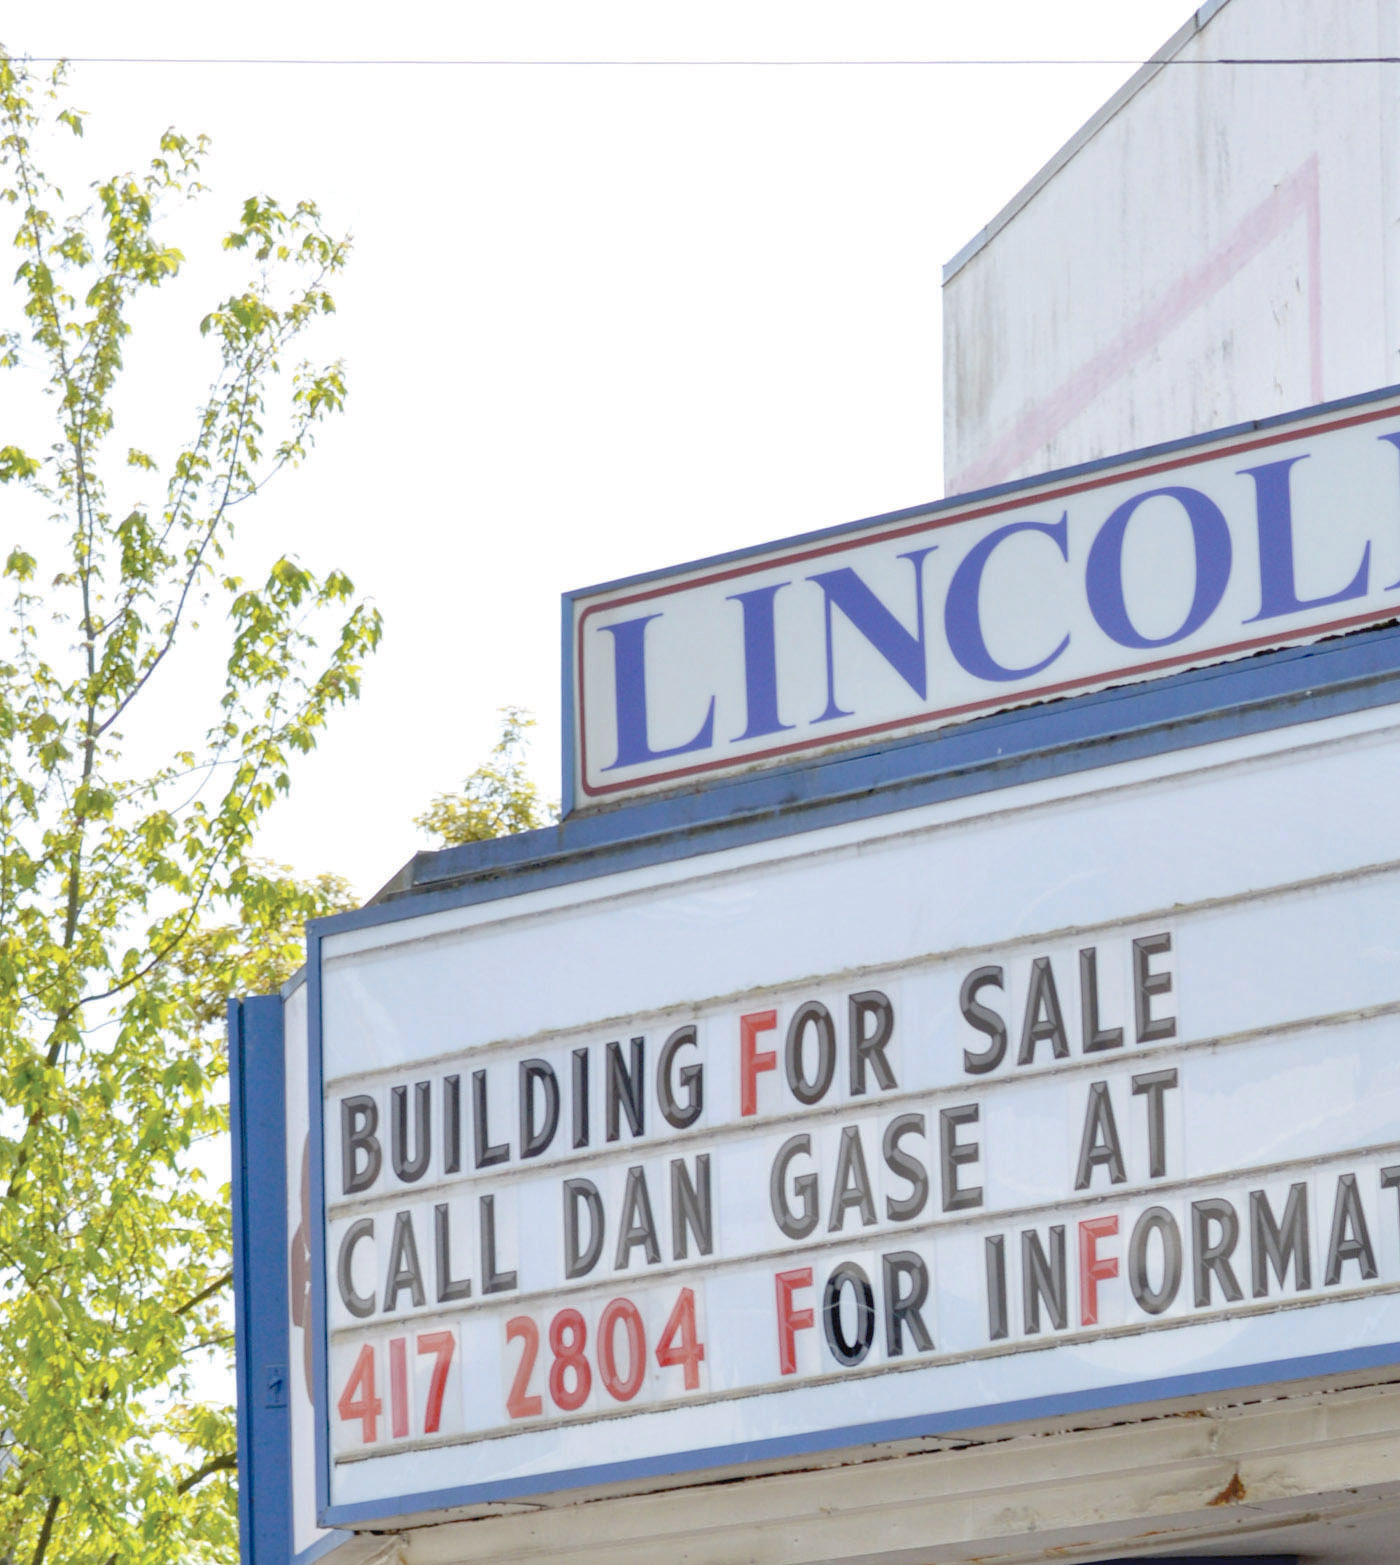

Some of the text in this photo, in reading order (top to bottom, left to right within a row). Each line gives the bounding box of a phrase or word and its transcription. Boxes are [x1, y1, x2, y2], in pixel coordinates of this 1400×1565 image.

[341, 931, 1177, 1196] BUILDING FOR SALE
[337, 1067, 1178, 1320] CALL DAN GASE AT
[338, 1329, 456, 1444] 417
[506, 1286, 705, 1420] 2804
[774, 1250, 935, 1376] FOR
